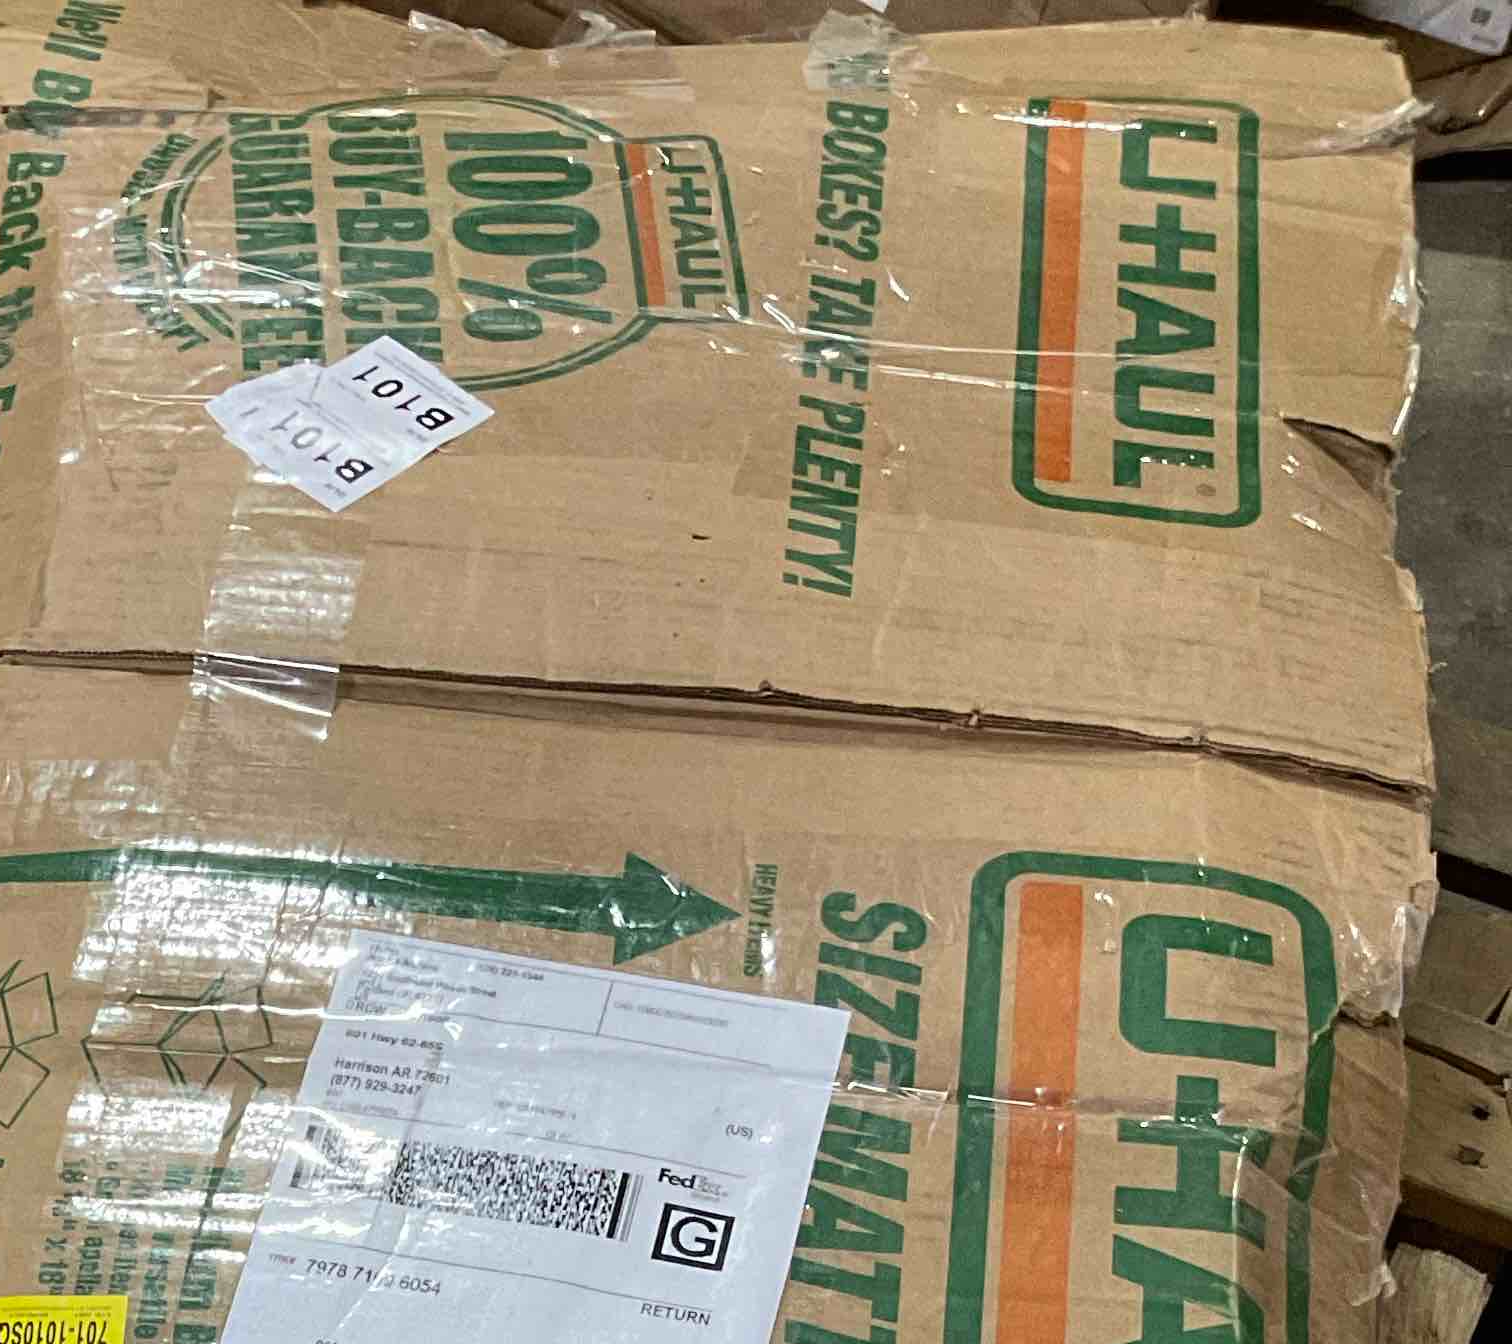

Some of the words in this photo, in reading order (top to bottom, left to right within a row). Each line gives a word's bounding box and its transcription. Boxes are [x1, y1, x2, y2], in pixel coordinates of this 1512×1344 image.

[815, 100, 889, 263] BOXES?
[328, 111, 443, 363] BUY-BACK
[443, 131, 613, 342] 100%
[797, 275, 878, 391] TAKE
[352, 366, 454, 431] B101
[782, 394, 868, 598] PLENTY!
[814, 890, 929, 1089] SIZE
[334, 1058, 388, 1075] Harrison
[391, 1064, 411, 1078] AR
[364, 1078, 423, 1096] 929-3247
[725, 1123, 753, 1141] (US)
[670, 1216, 718, 1258] G
[306, 1258, 348, 1279] 7978
[398, 1275, 442, 1296] 6054
[640, 1302, 711, 1326] RETURN
